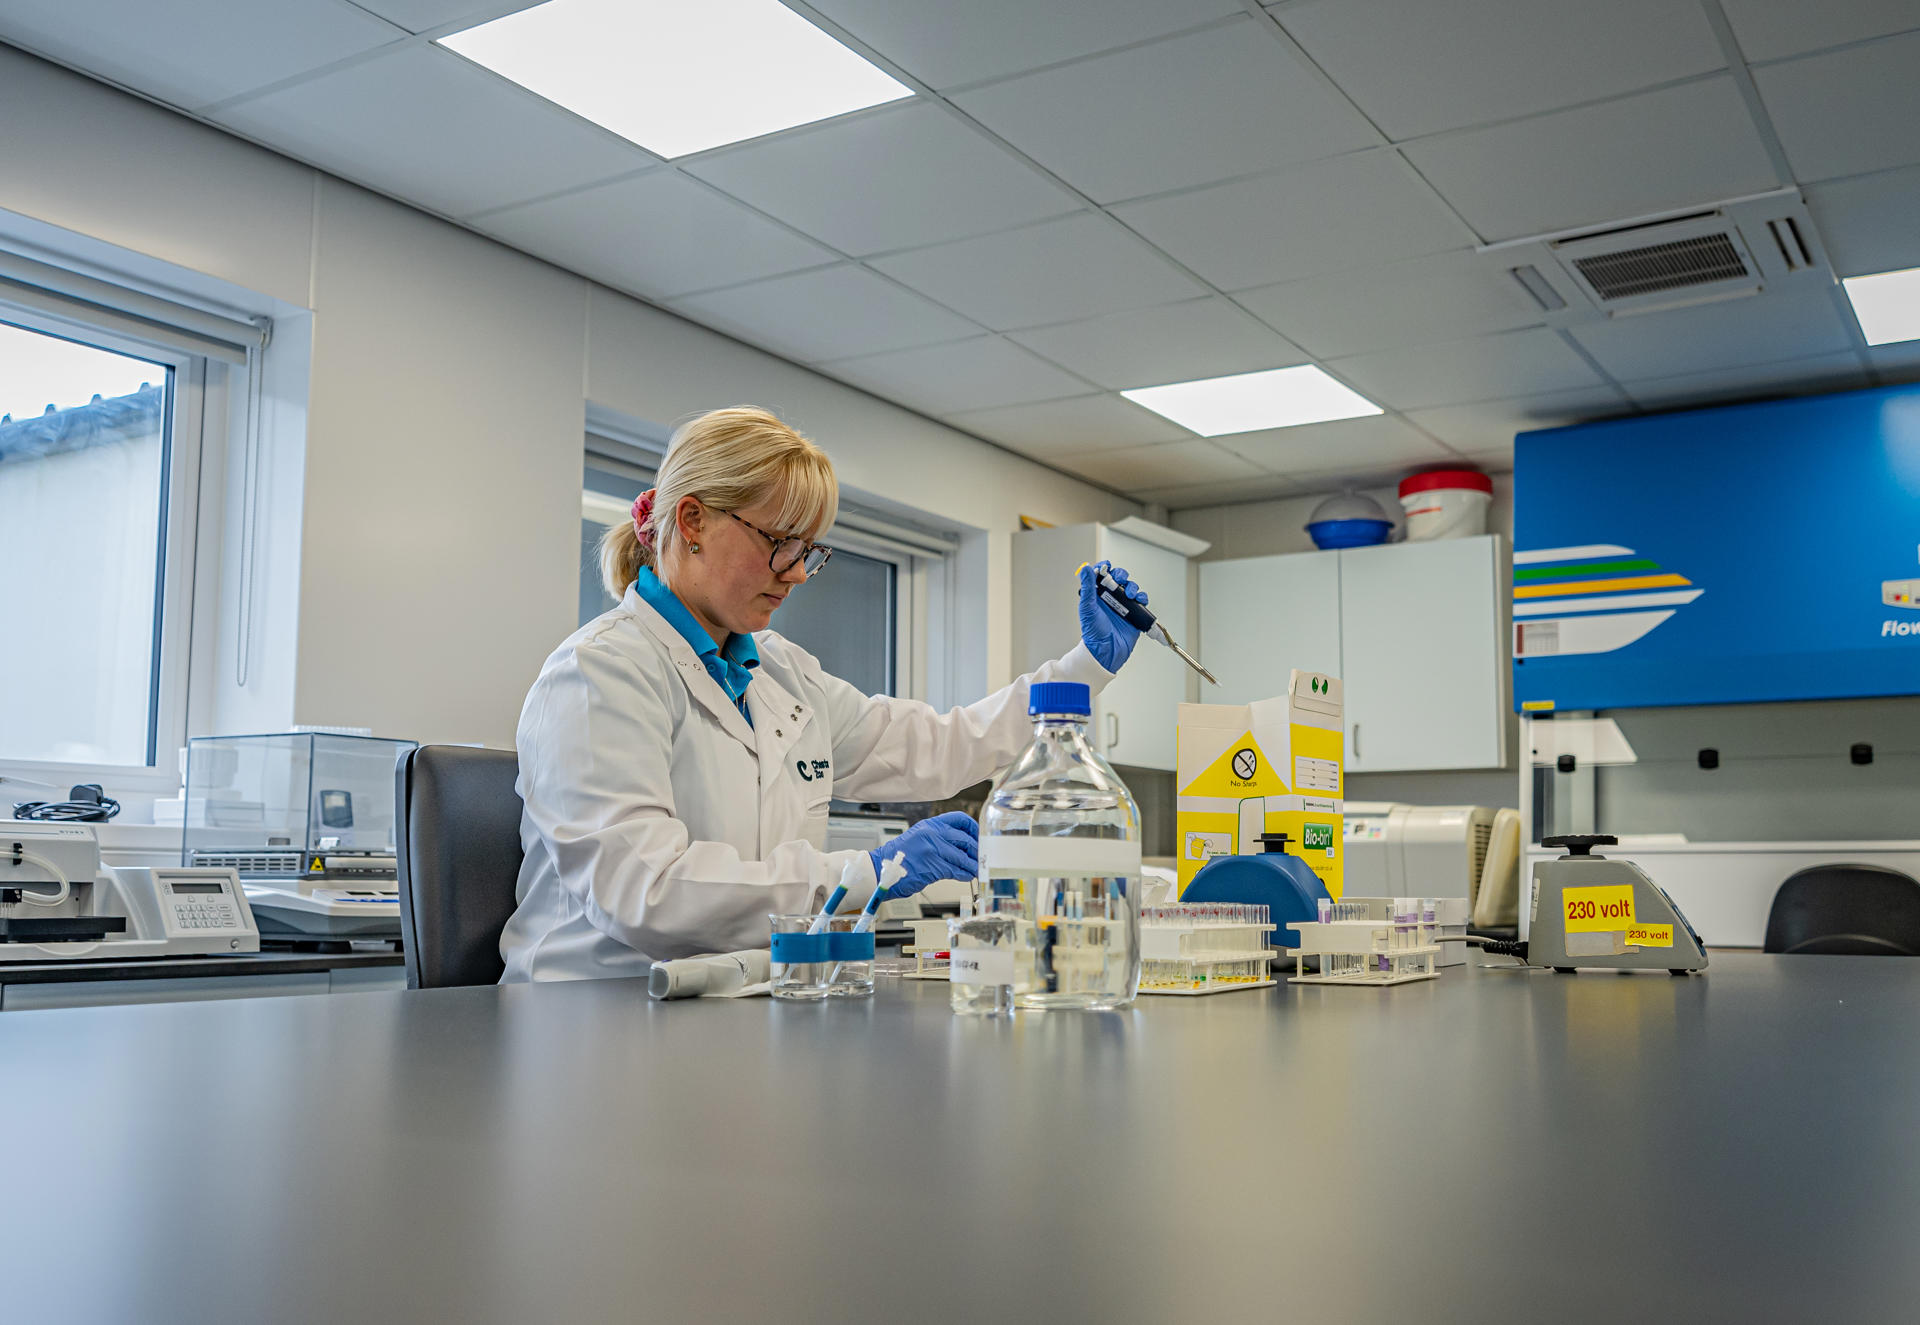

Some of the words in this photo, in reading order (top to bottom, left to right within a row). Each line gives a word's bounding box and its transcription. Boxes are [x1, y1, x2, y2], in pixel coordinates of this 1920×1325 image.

[1568, 901, 1595, 919] 230
[1600, 899, 1630, 918] volt
[1629, 930, 1647, 939] 230
[1650, 931, 1668, 940] volt
